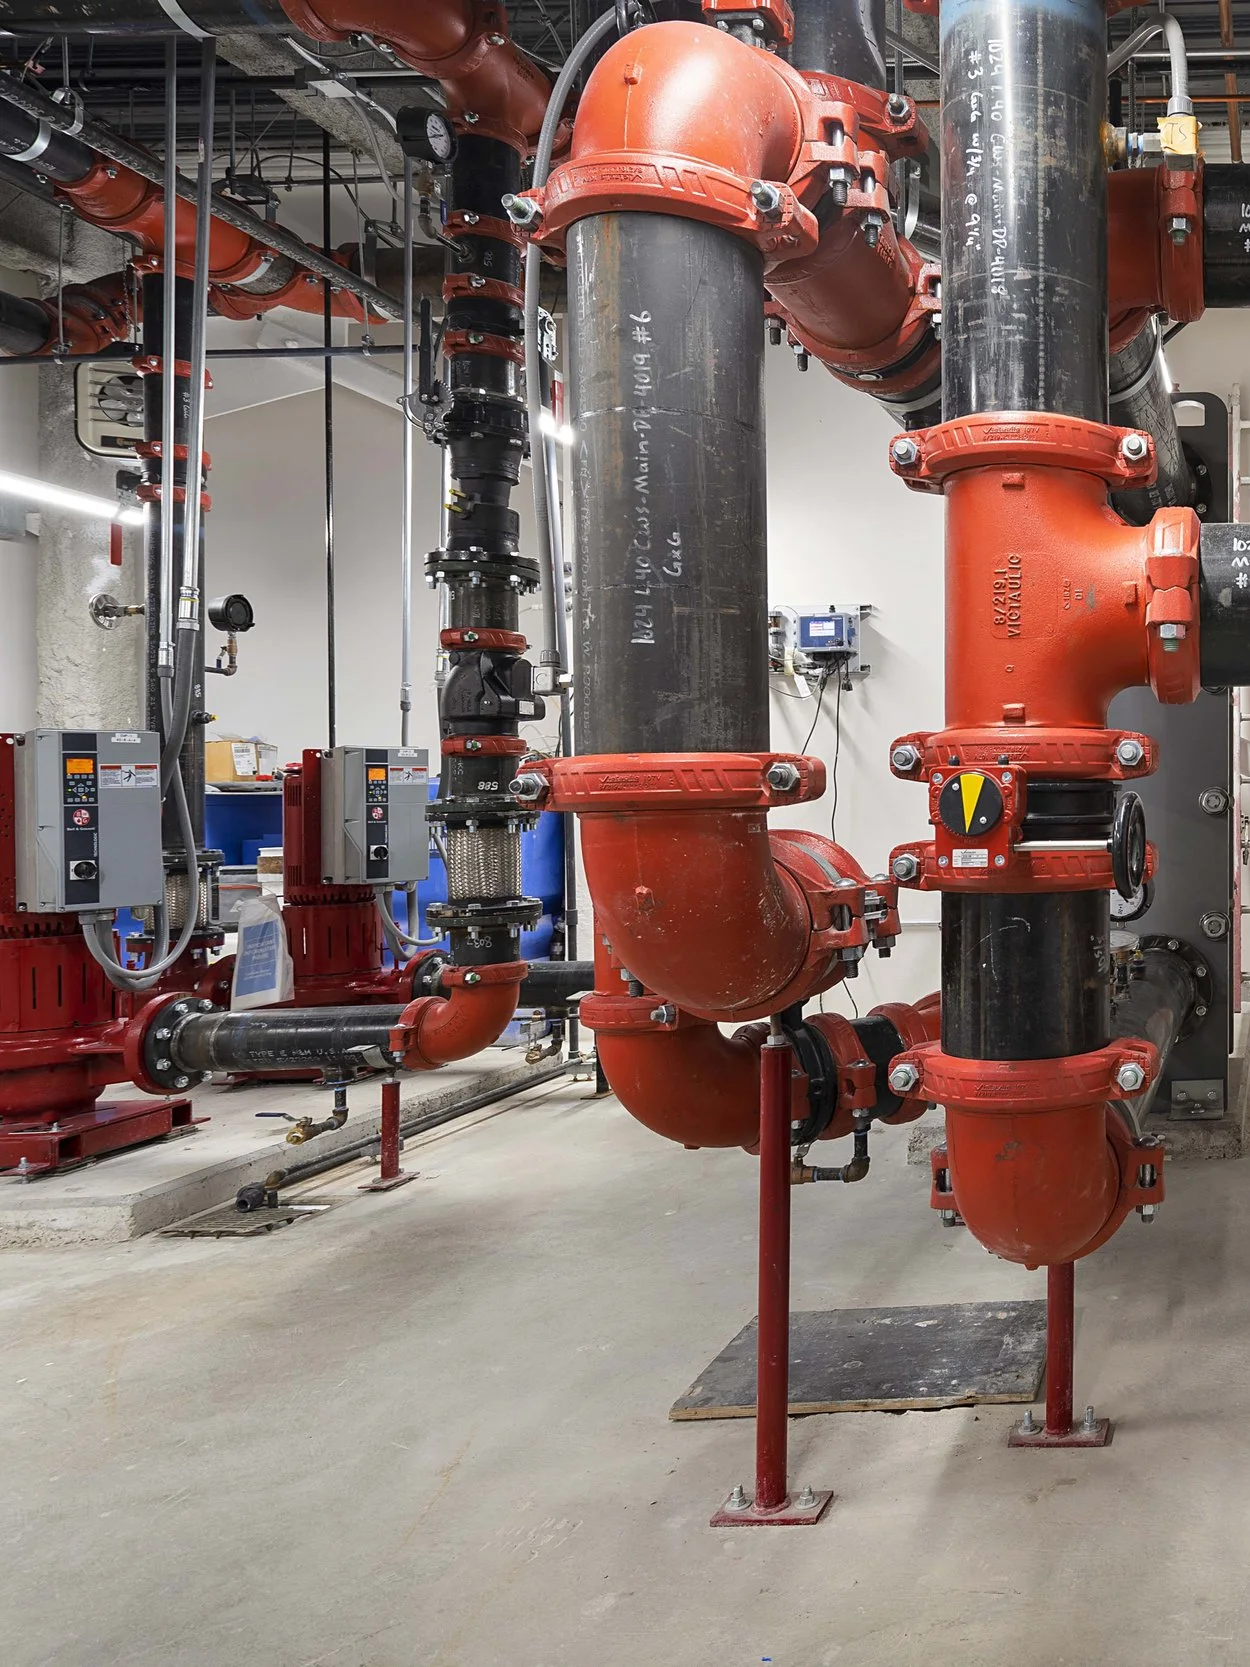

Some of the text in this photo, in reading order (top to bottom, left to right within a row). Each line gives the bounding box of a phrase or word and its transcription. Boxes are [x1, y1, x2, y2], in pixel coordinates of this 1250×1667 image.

[968, 50, 984, 79] #3
[987, 39, 1004, 76] 1024
[965, 193, 978, 205] @
[629, 310, 652, 344] #6
[662, 531, 683, 577] GxG
[1007, 553, 1022, 638] VICTAULIC
